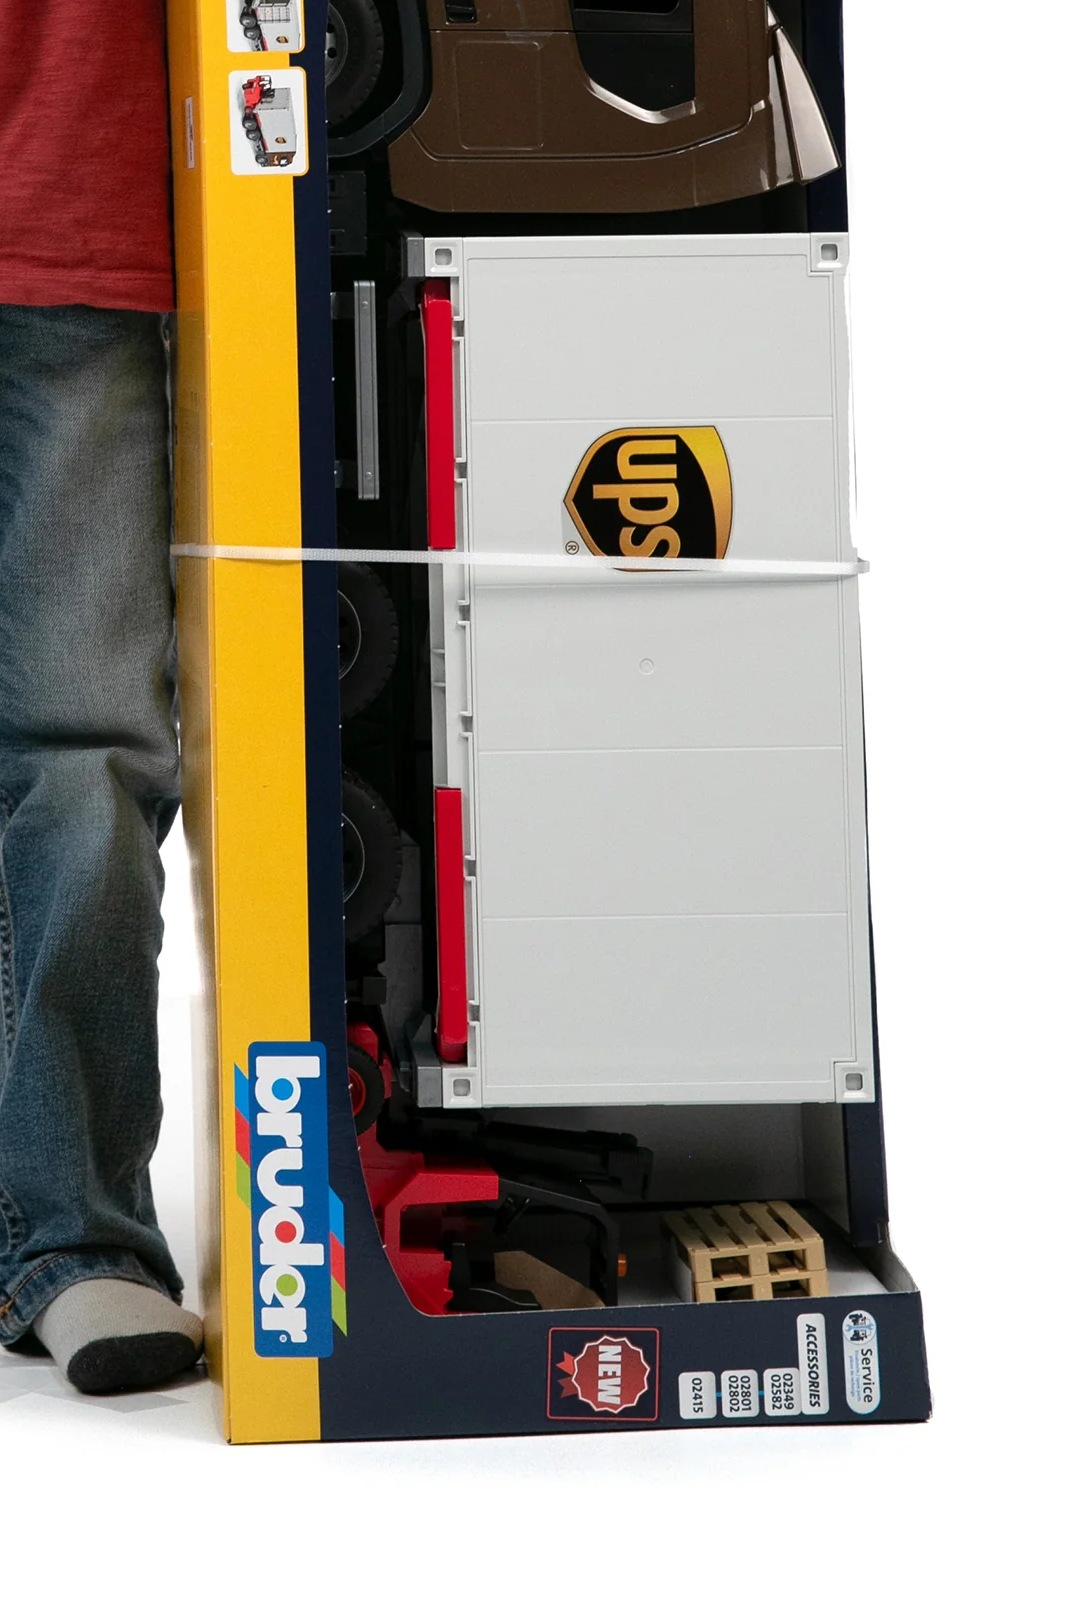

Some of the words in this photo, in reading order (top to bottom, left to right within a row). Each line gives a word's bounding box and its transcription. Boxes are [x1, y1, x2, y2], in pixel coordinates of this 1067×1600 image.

[592, 439, 681, 558] ups
[254, 1056, 324, 1343] bruder
[597, 1345, 622, 1405] NEW
[805, 1323, 821, 1408] ACCESSORIES
[861, 1348, 875, 1403] Service
[691, 1377, 703, 1413] 02415
[728, 1375, 740, 1413] 02802
[740, 1375, 752, 1412] 02801
[770, 1374, 782, 1410] 02582
[782, 1373, 794, 1410] 02349
